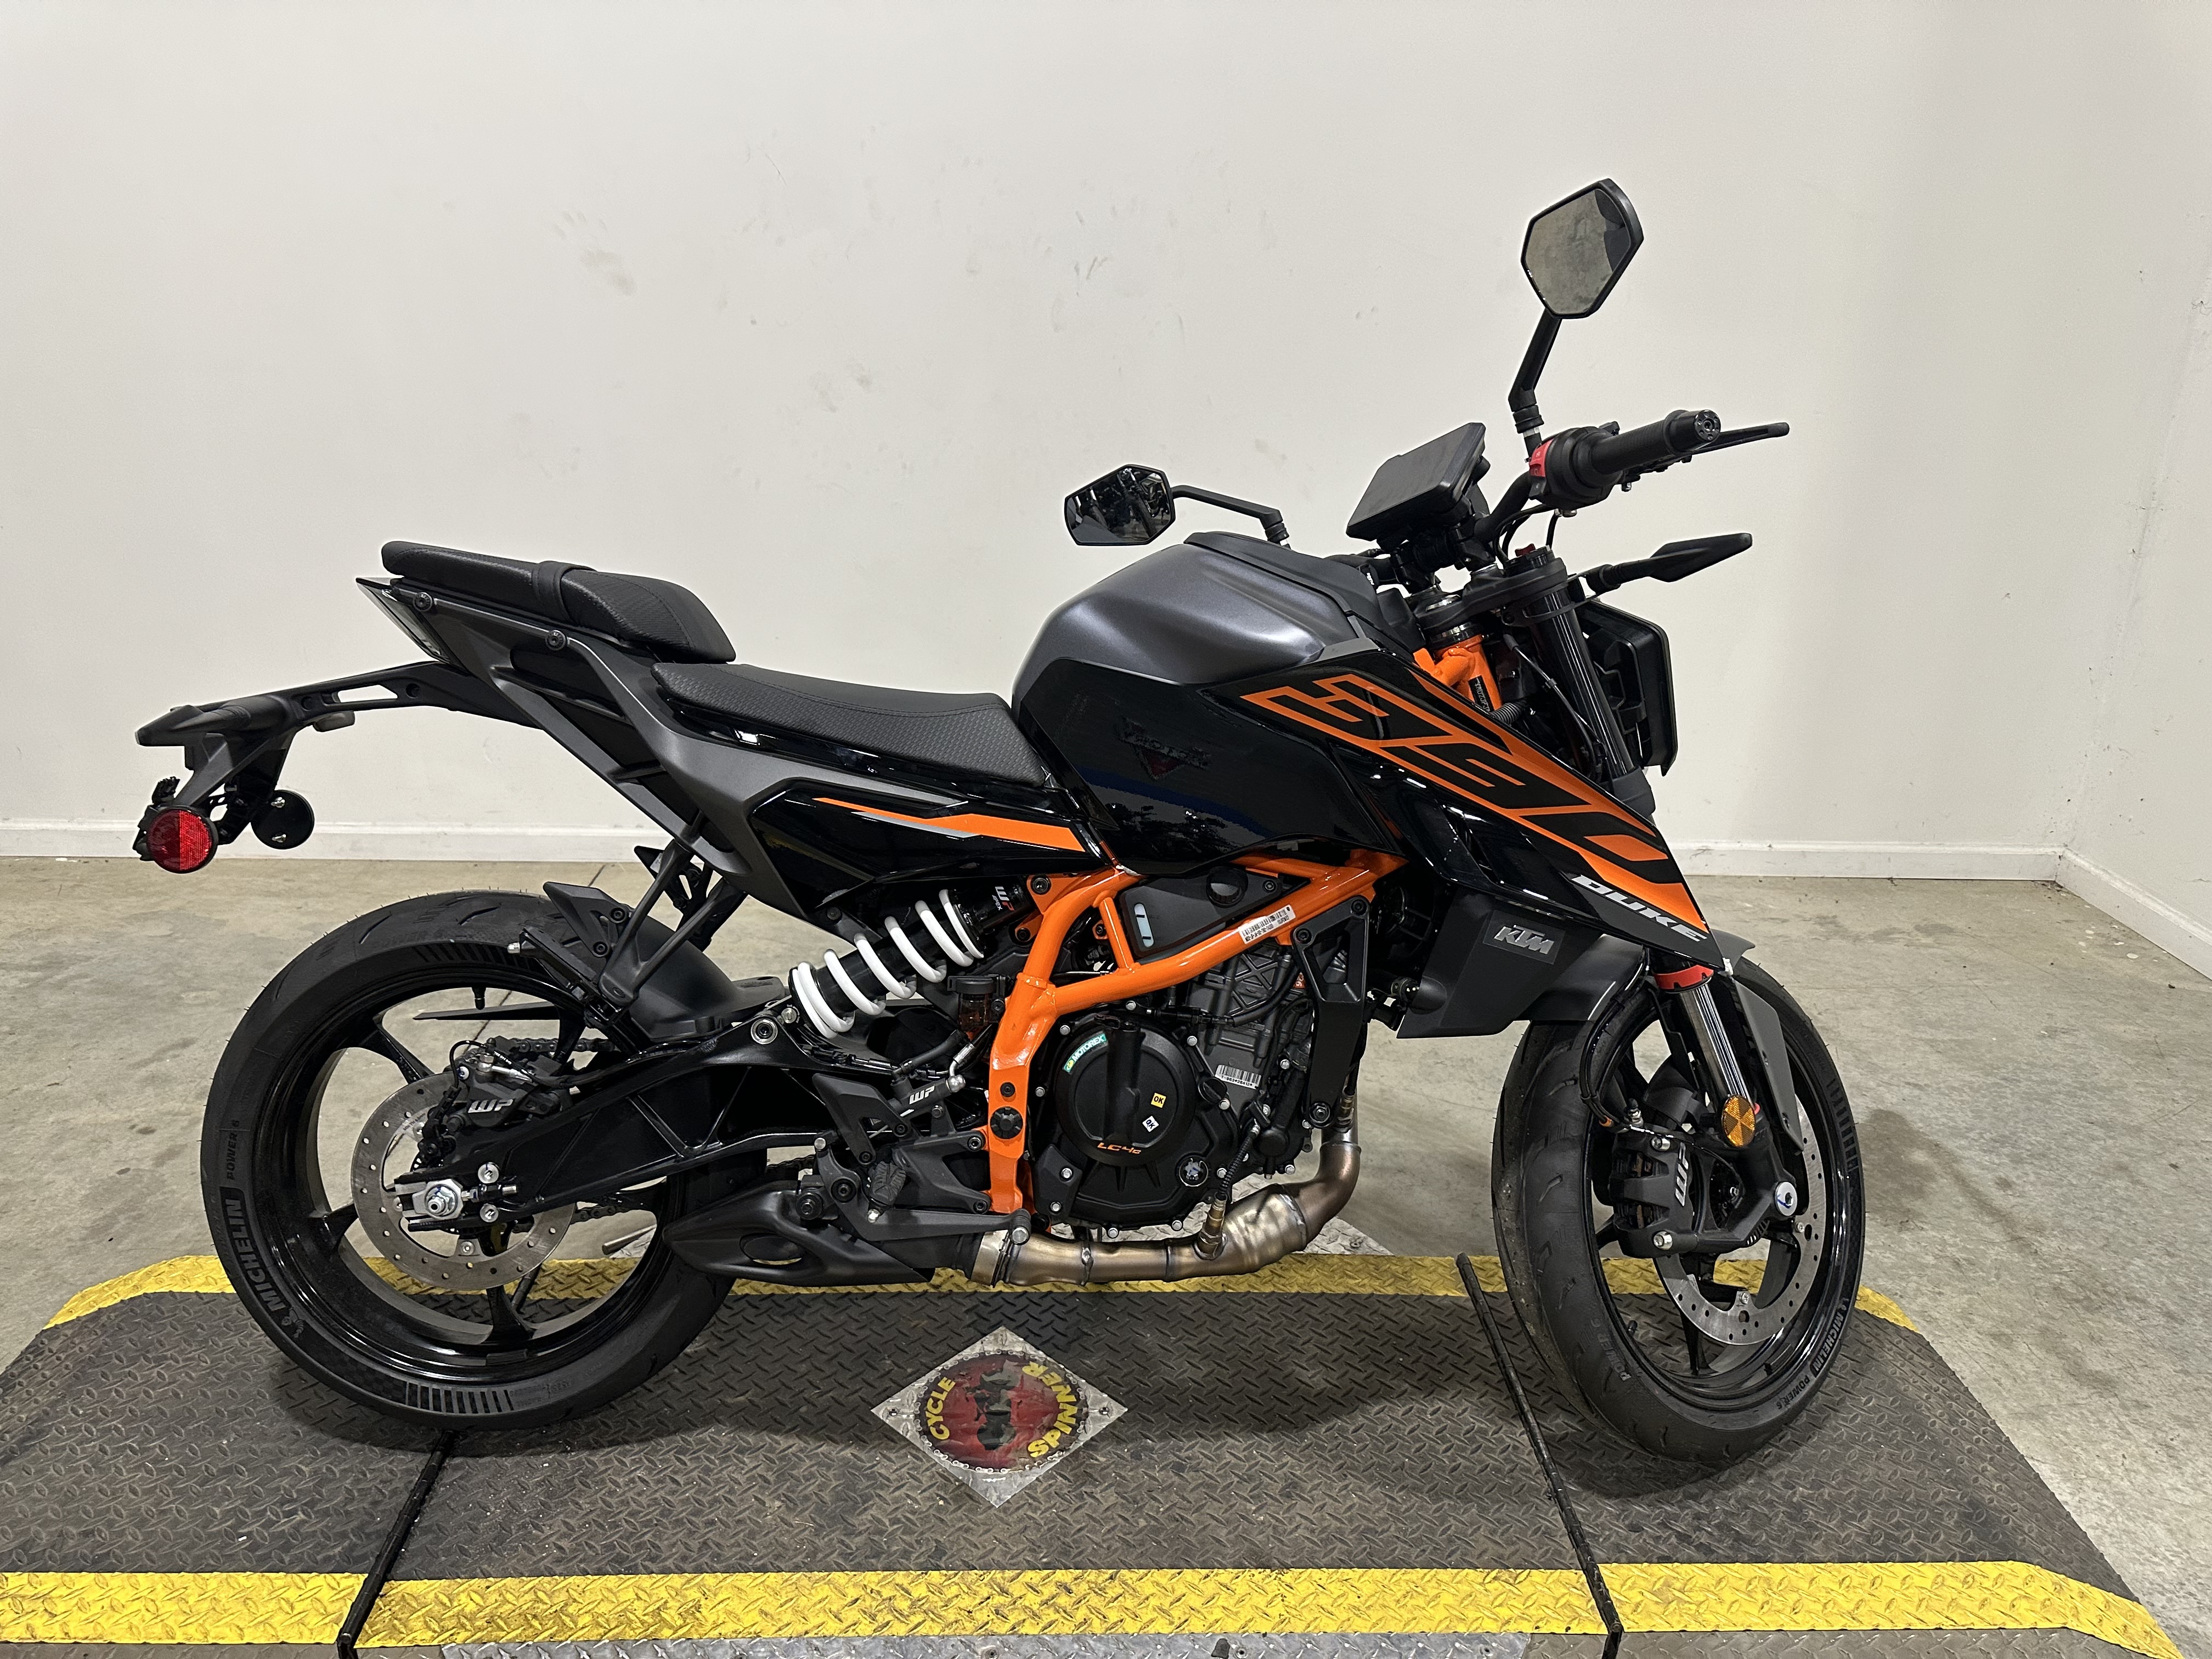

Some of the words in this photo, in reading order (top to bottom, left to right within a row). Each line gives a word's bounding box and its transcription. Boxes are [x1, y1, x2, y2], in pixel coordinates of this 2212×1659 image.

[995, 887, 1014, 911] WP
[1571, 874, 1707, 941] DUKE
[1494, 925, 1554, 954] KTM
[1072, 1035, 1104, 1061] MOTOREX
[468, 1099, 513, 1113] WP
[909, 1086, 935, 1104] WP
[1146, 1119, 1156, 1129] OK
[227, 1132, 238, 1180] POWER
[1675, 1142, 1689, 1206] WP
[225, 1199, 286, 1312] MICHELIN
[1597, 1333, 1632, 1381] POWER
[1813, 1312, 1844, 1371] MICHELIN
[926, 1376, 956, 1440] CYCLE
[1022, 1361, 1077, 1457] SPINNER
[1783, 1375, 1810, 1405] POWER
